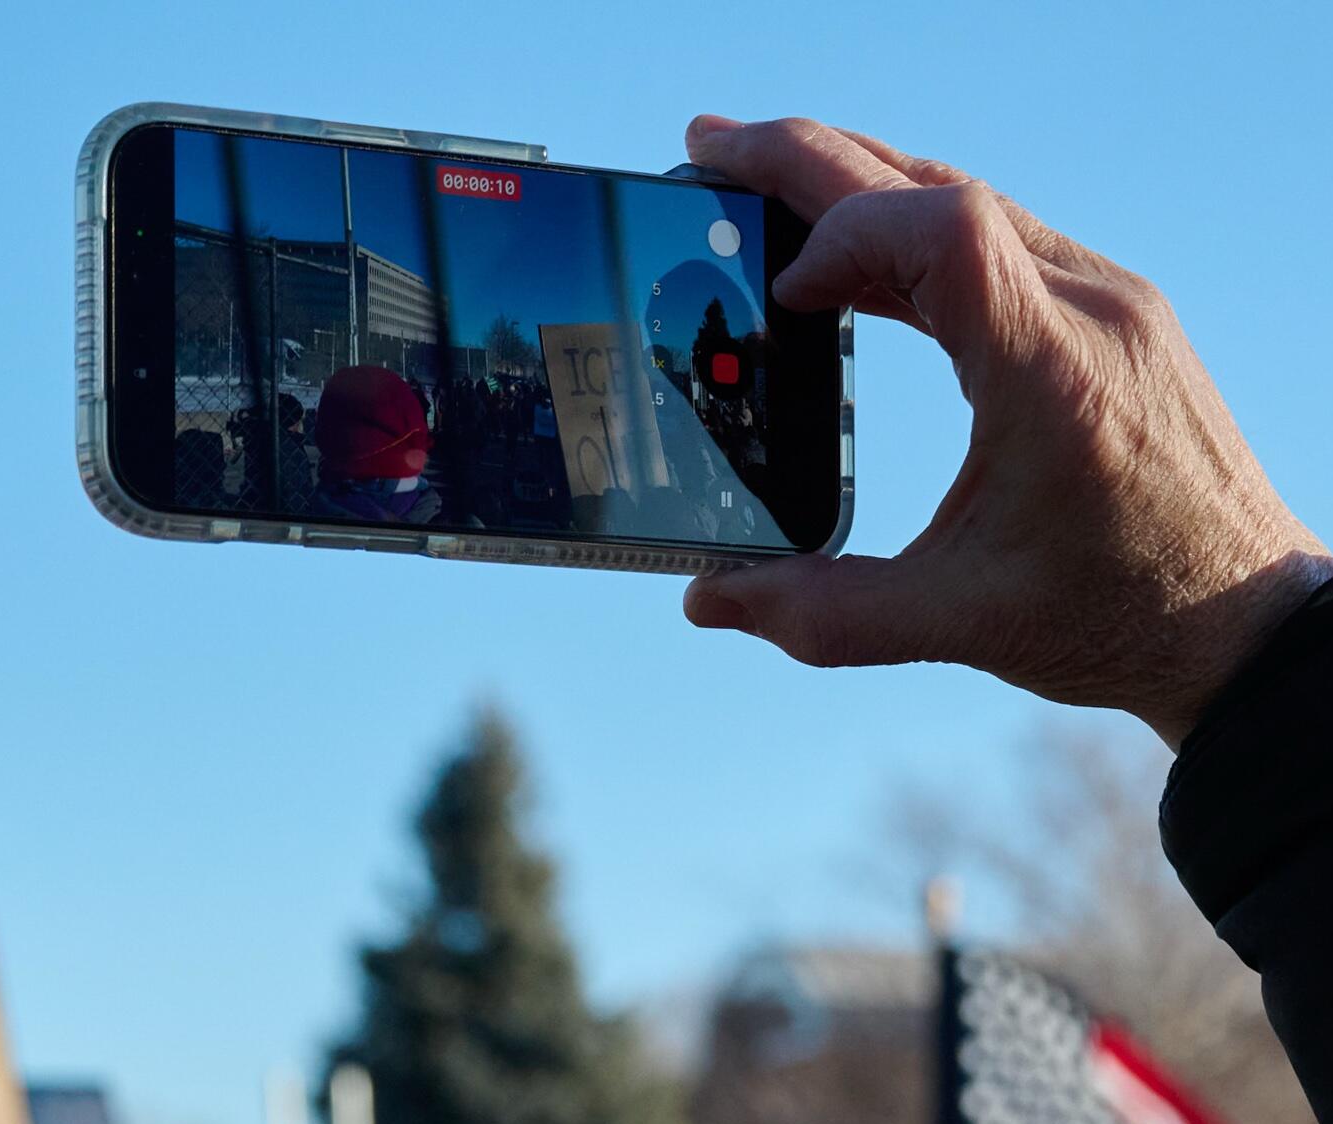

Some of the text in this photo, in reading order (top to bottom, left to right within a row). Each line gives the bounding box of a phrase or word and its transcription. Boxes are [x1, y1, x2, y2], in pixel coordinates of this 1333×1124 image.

[443, 173, 515, 196] 00:00:10
[652, 282, 661, 296] 5
[653, 319, 661, 332] 2
[651, 392, 665, 406] .5
